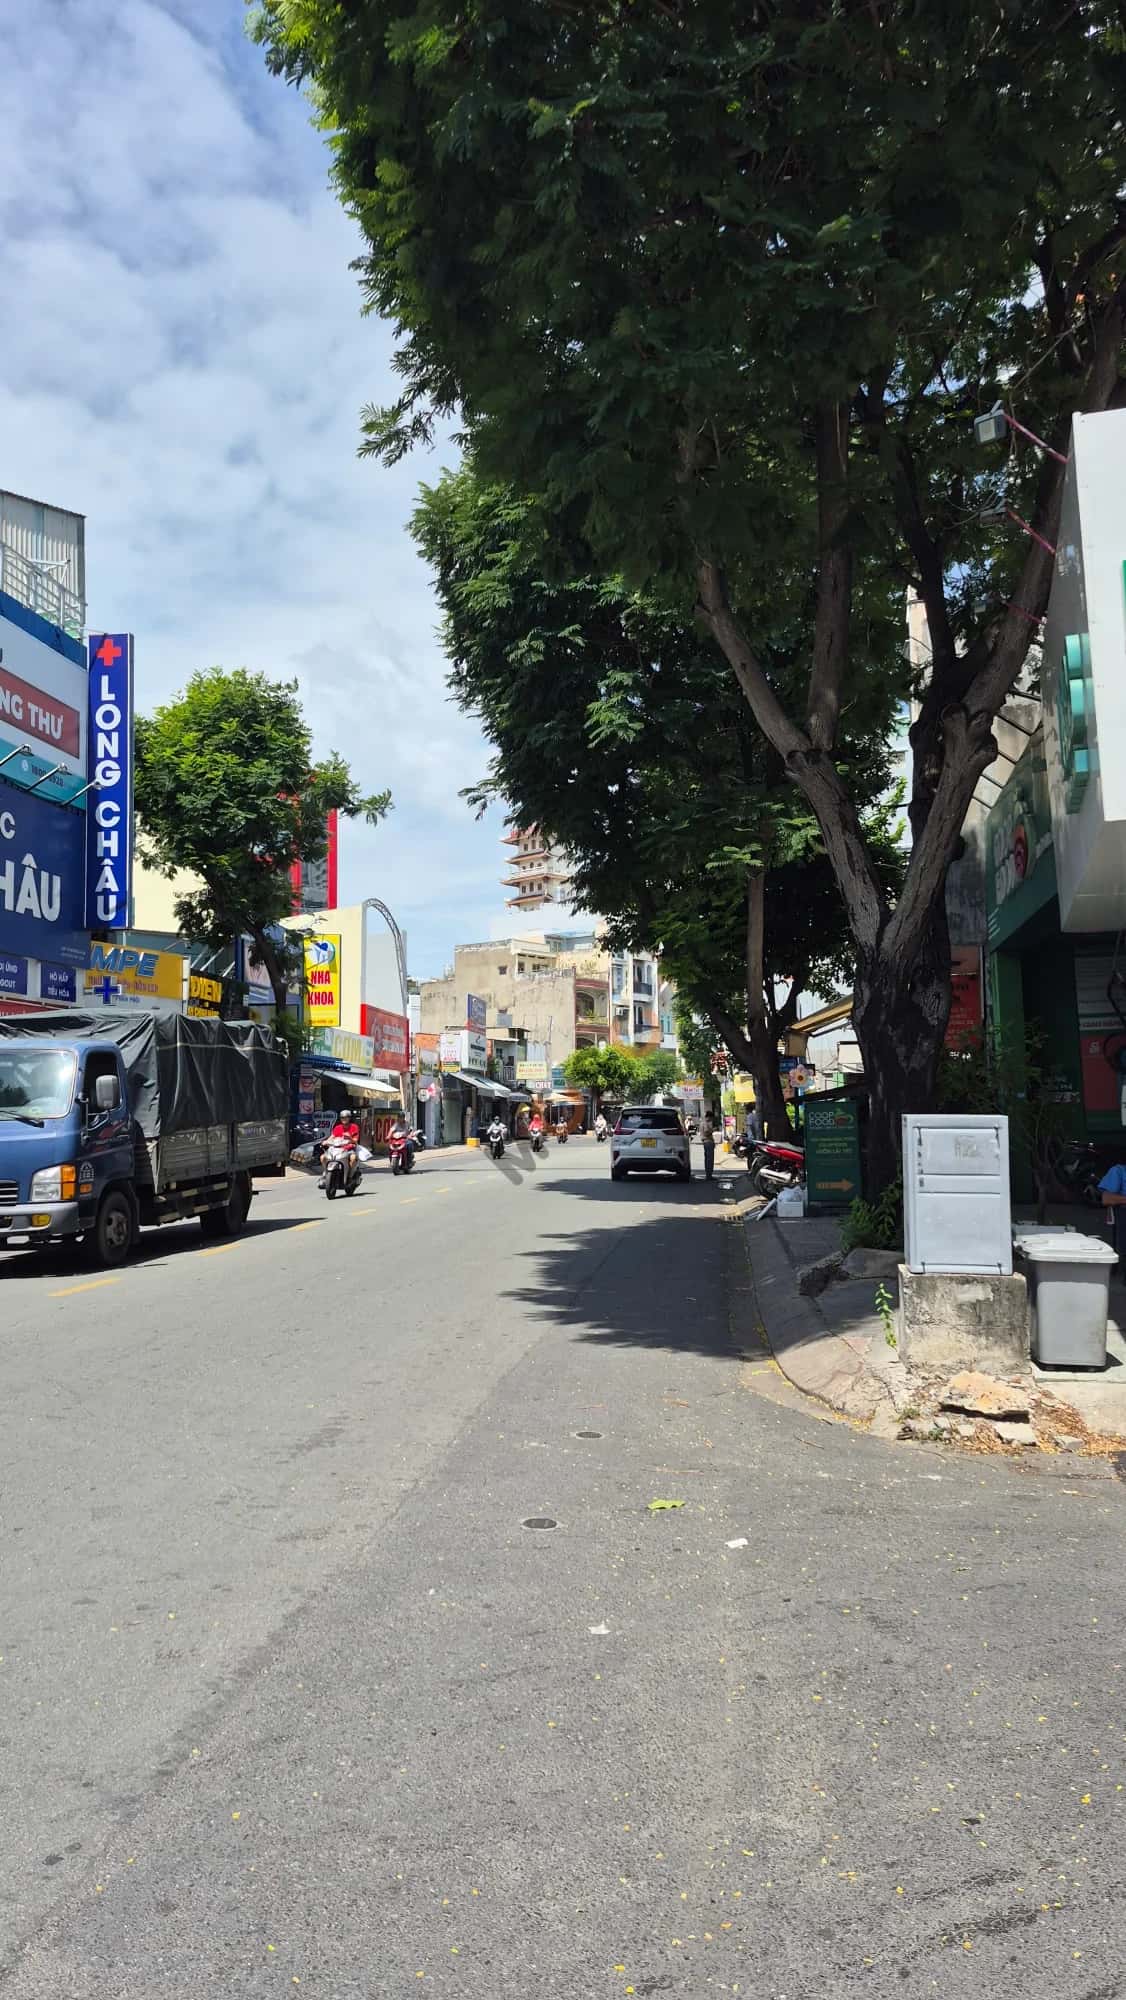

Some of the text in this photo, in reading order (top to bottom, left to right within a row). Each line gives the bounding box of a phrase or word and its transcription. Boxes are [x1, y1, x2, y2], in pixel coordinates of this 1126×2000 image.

[28, 702, 64, 740] THƯ
[95, 675, 122, 922] LONG CHÂU
[90, 943, 159, 978] MPE
[310, 970, 331, 985] NHA
[308, 991, 334, 1006] KHOA
